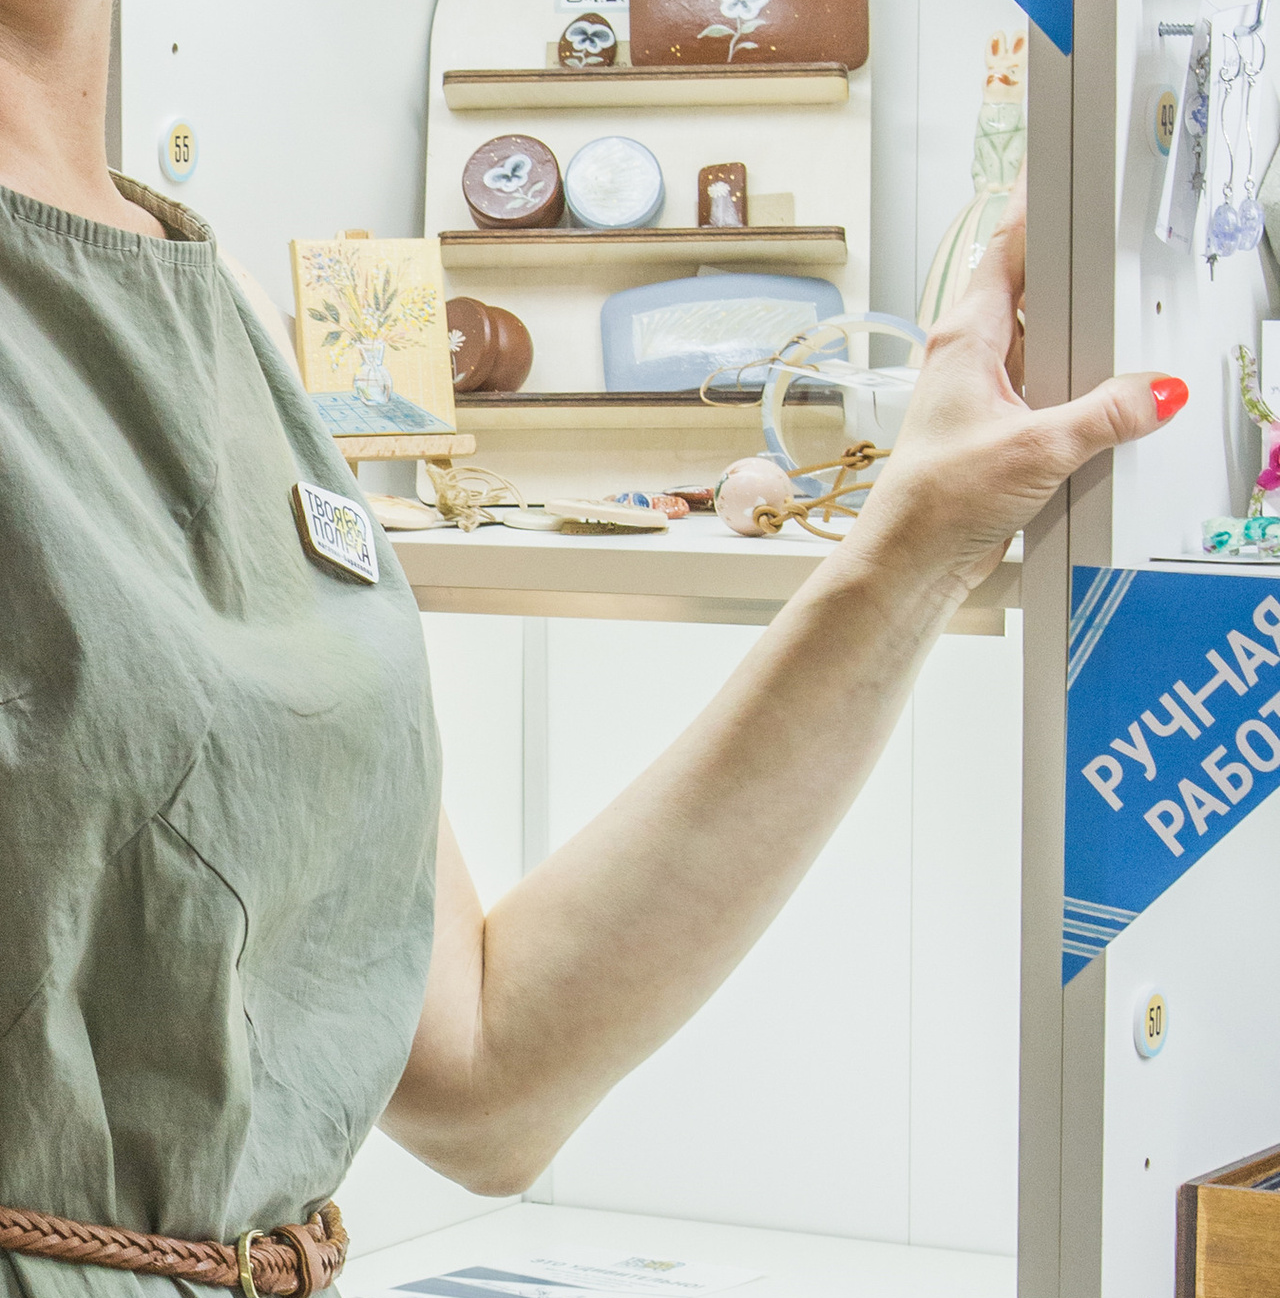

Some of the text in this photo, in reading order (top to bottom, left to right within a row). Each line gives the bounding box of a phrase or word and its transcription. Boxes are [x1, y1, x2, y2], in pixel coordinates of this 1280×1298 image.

[1161, 104, 1174, 136] 49
[174, 135, 190, 163] 55
[305, 489, 343, 527] ТВОЯ
[1148, 1005, 1162, 1038] 50
